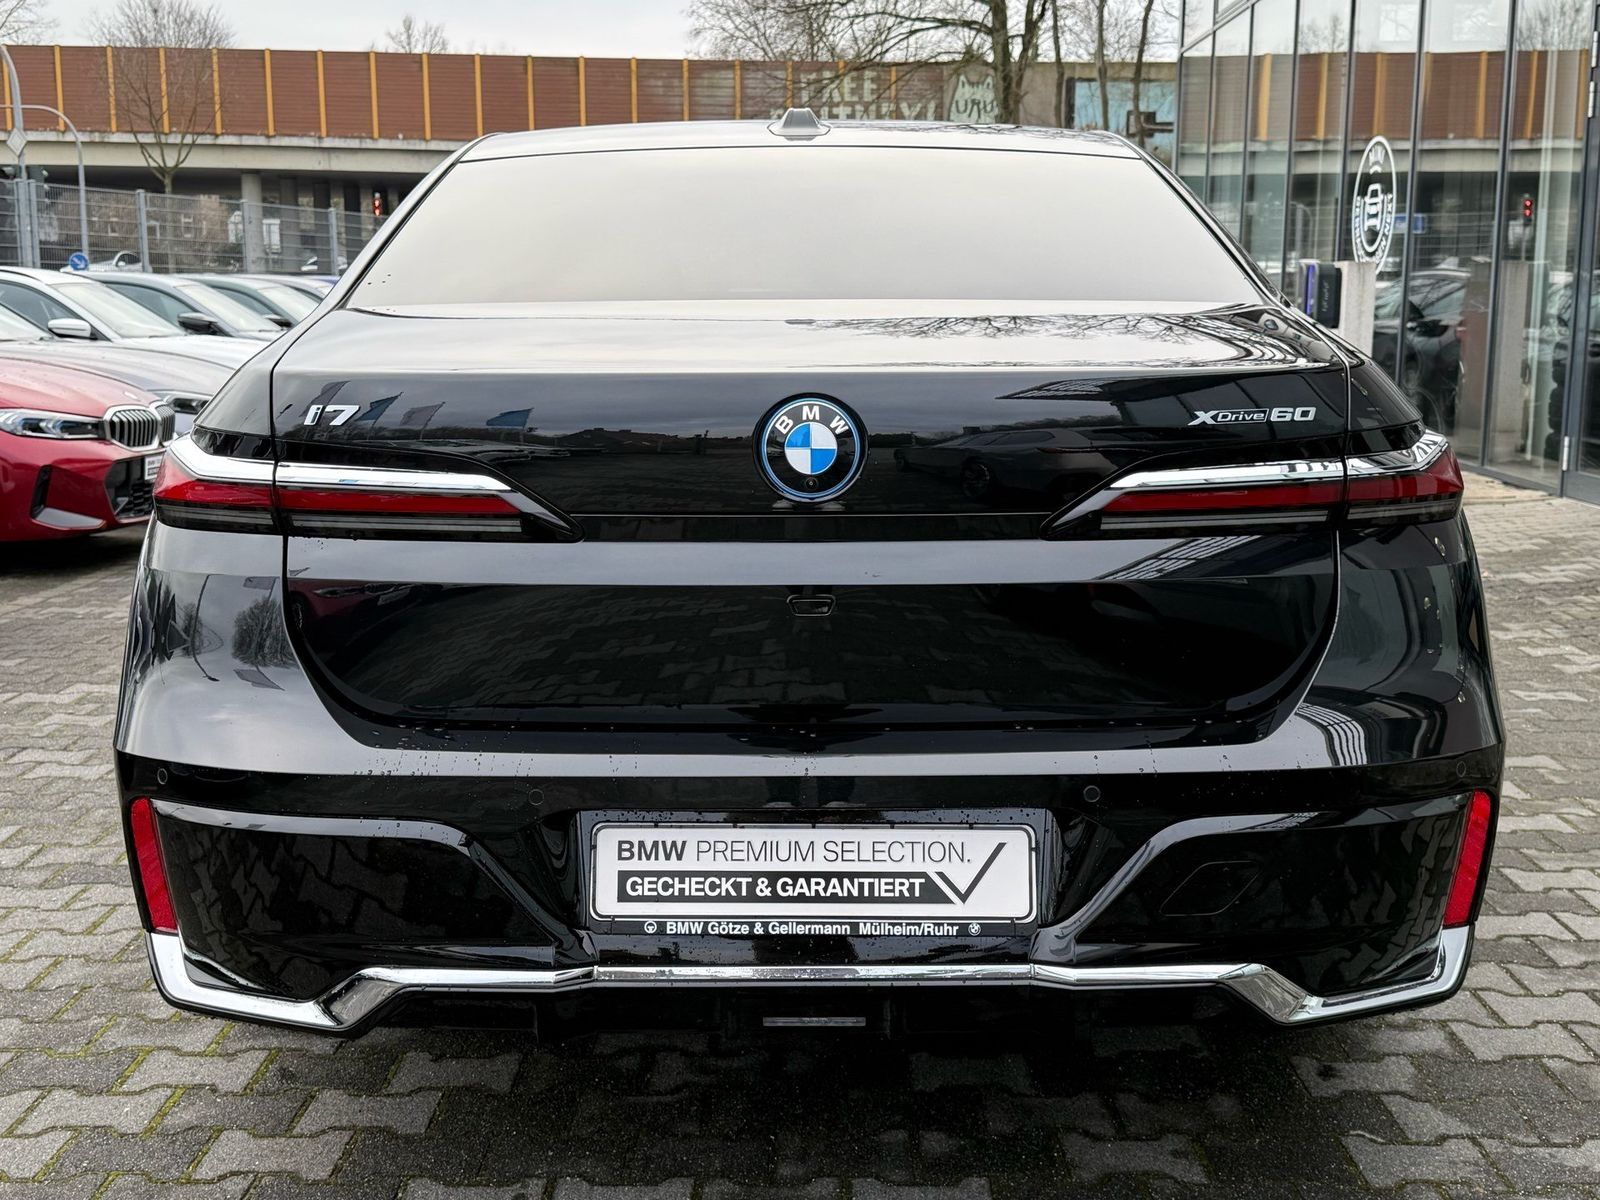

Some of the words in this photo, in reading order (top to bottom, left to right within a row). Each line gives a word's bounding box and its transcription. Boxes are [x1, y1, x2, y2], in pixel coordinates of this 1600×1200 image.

[303, 404, 361, 426] i7
[774, 405, 849, 435] BMW
[617, 840, 688, 861] BMW
[696, 840, 815, 862] PREMIUM
[823, 841, 972, 863] SELECTION.
[625, 876, 752, 897] GECHECKT
[755, 876, 772, 897] &
[776, 877, 926, 897] GARANTIERT
[666, 922, 704, 935] BMW
[707, 921, 749, 935] Götze
[753, 922, 764, 935] &
[768, 922, 850, 936] Gellermann
[859, 921, 959, 936] Mülheim/Ruhr
